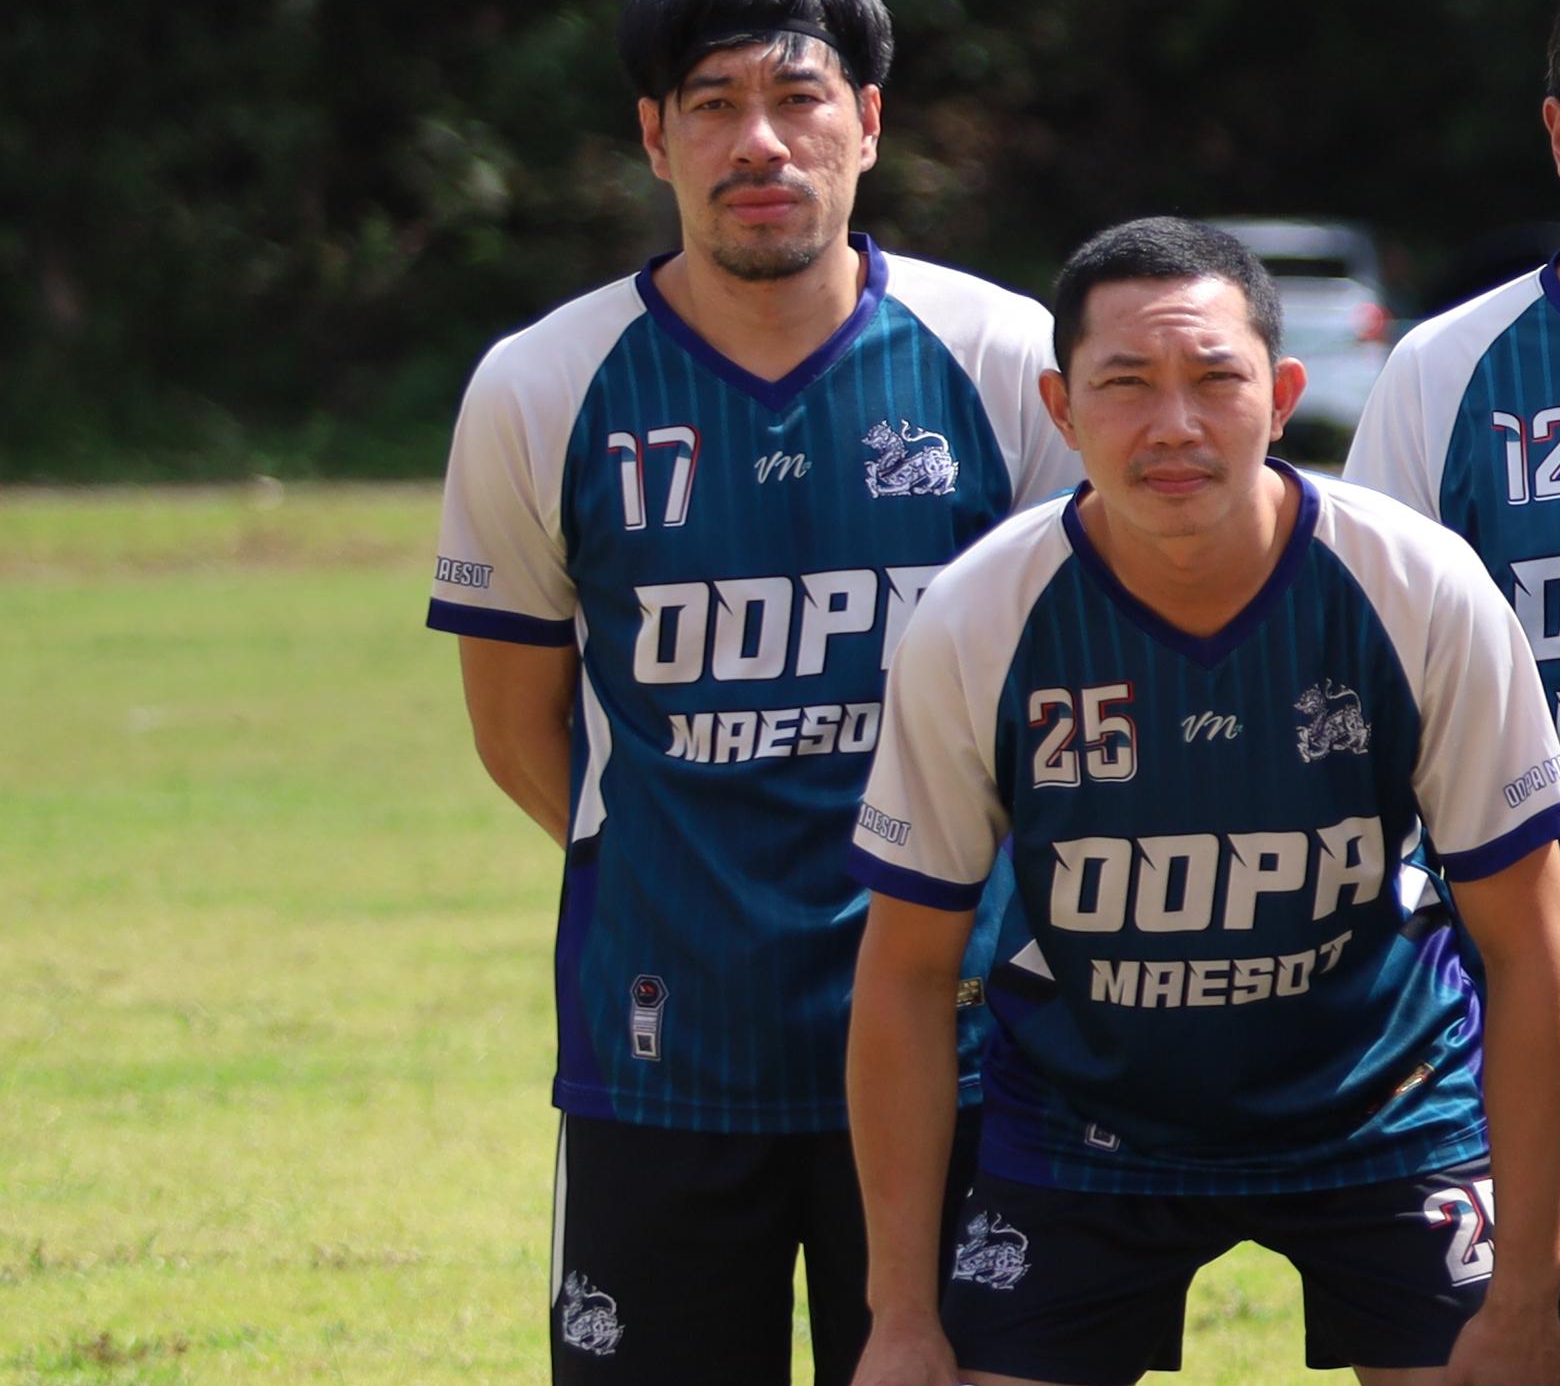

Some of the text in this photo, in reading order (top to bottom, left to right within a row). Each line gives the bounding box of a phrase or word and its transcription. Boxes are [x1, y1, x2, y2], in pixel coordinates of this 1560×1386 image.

[607, 425, 701, 530] 17
[435, 556, 493, 589] AESOT
[665, 703, 882, 764] MAESO
[1028, 681, 1138, 788] 25
[1050, 816, 1386, 934] DOPA
[1090, 930, 1353, 1009] MAESOT
[1422, 1178, 1495, 1288] 2
